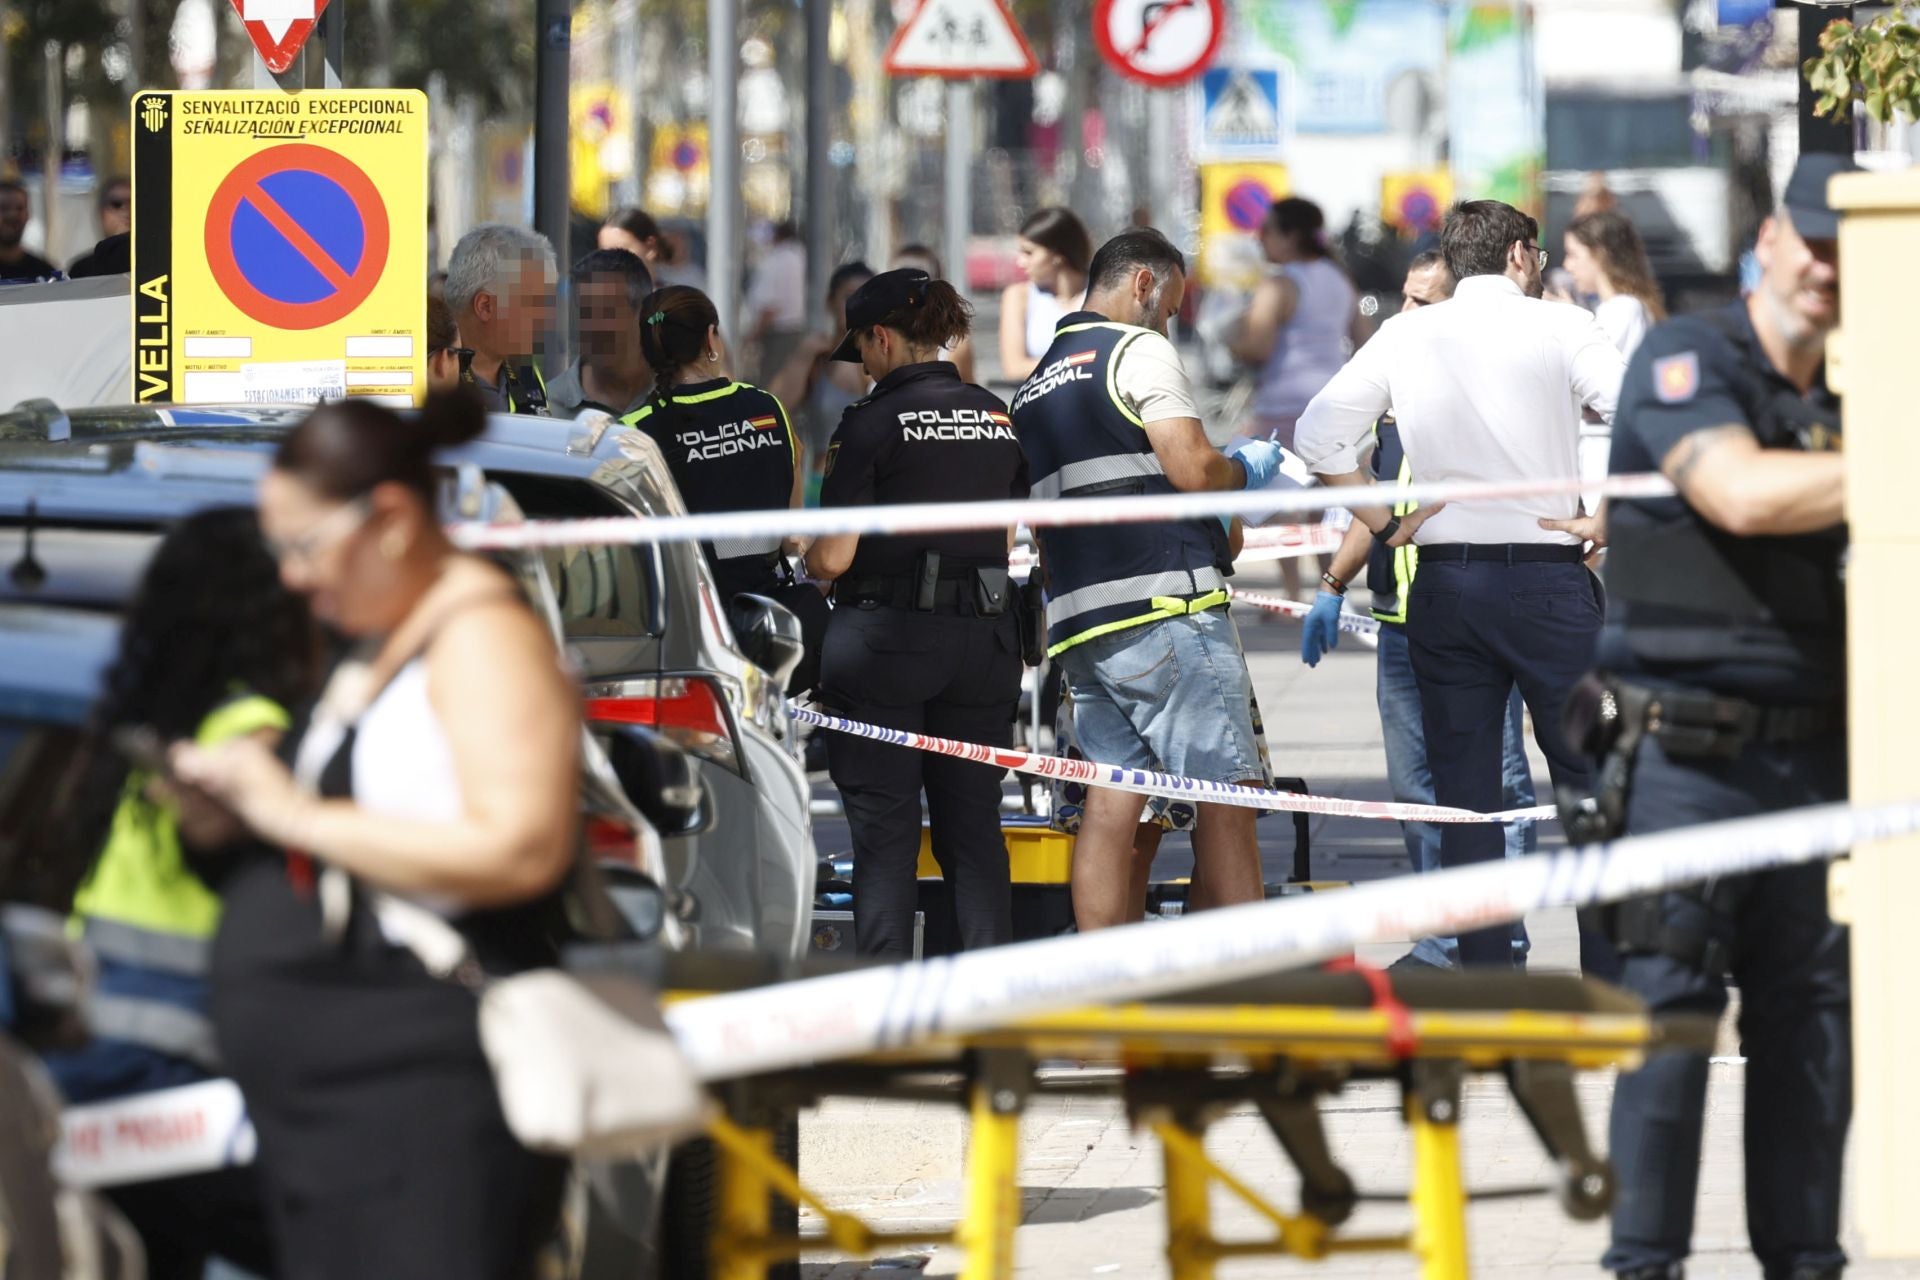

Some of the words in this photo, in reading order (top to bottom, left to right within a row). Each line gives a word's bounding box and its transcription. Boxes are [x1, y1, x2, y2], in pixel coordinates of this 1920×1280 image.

[182, 98, 300, 115] SENYALITZACIÓ
[309, 99, 414, 114] EXCEPCIONAL
[183, 117, 295, 135] SEÑALIZACIÓN
[299, 119, 403, 134] EXCEPCIONAL
[139, 274, 168, 400] VELLA
[1012, 365, 1093, 414] NACIONAL
[903, 425, 1018, 442] NACIONAL
